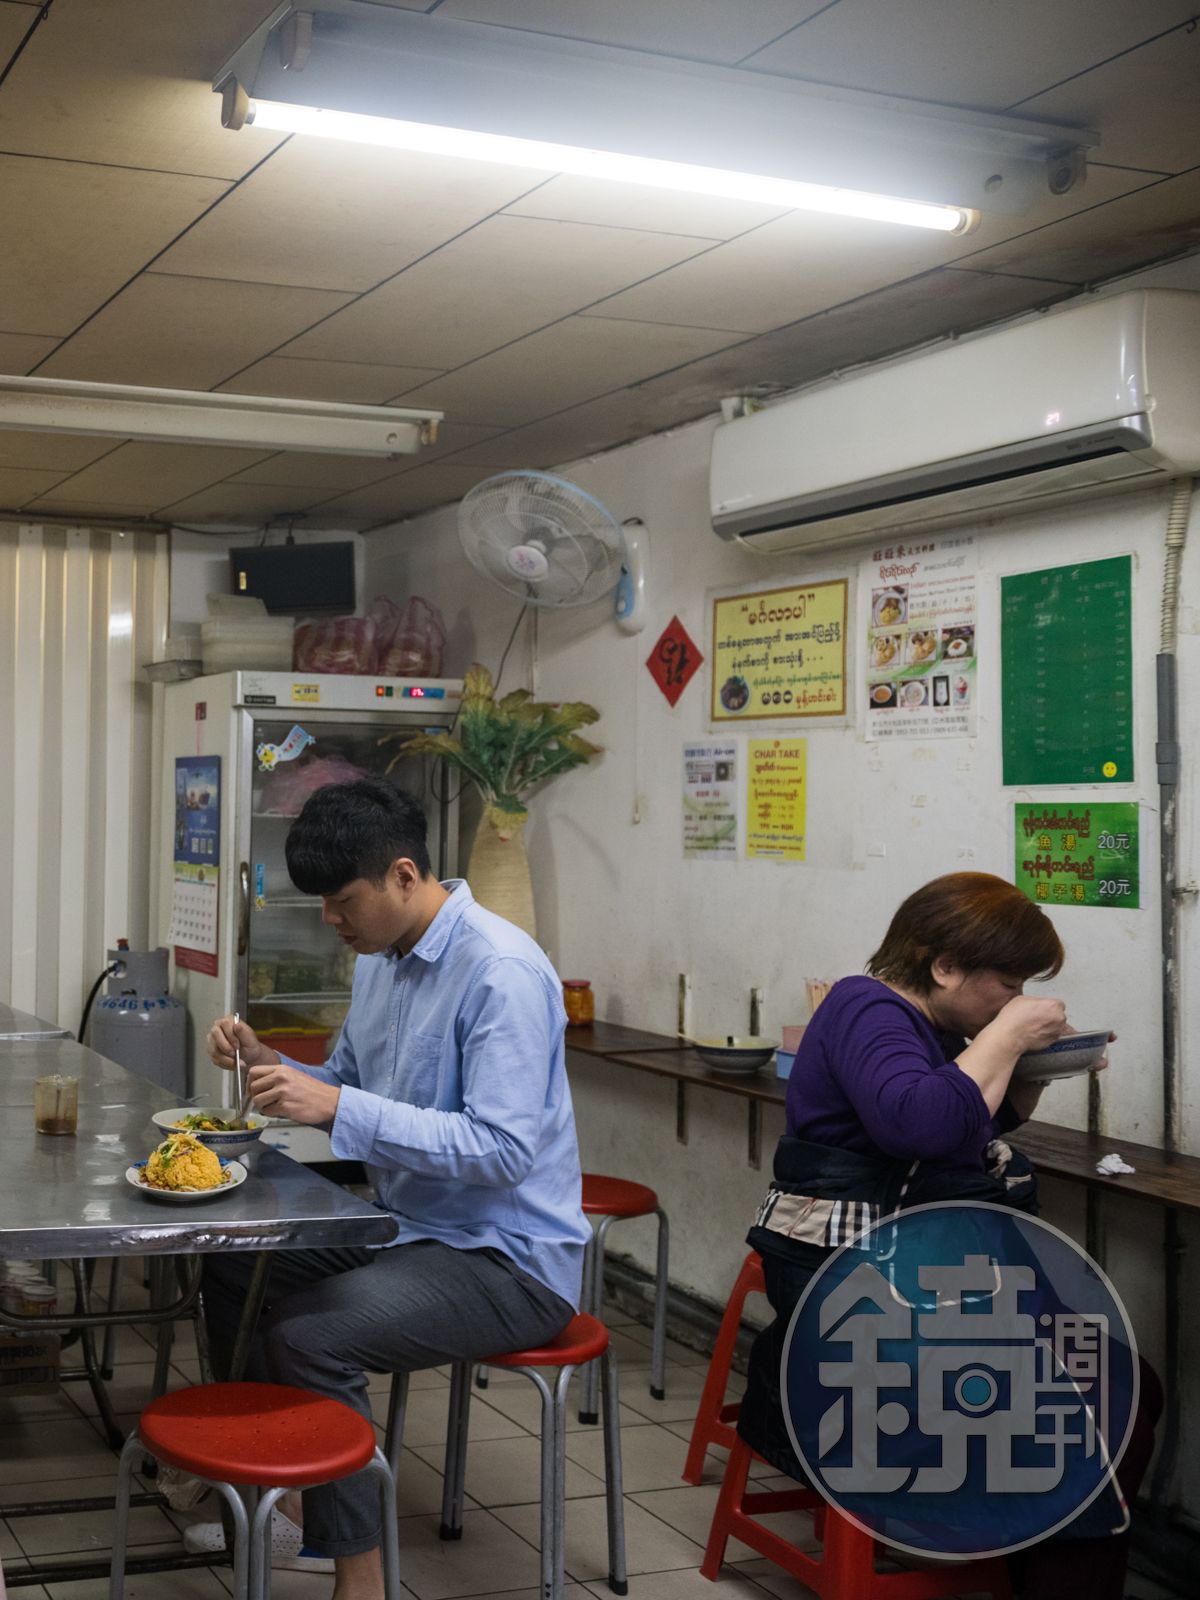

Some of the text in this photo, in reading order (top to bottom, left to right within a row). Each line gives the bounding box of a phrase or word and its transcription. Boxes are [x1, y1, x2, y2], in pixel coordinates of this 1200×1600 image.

[779, 749, 800, 759] TAKE
[1097, 833, 1130, 849] 20元
[1099, 879, 1131, 895] 20元
